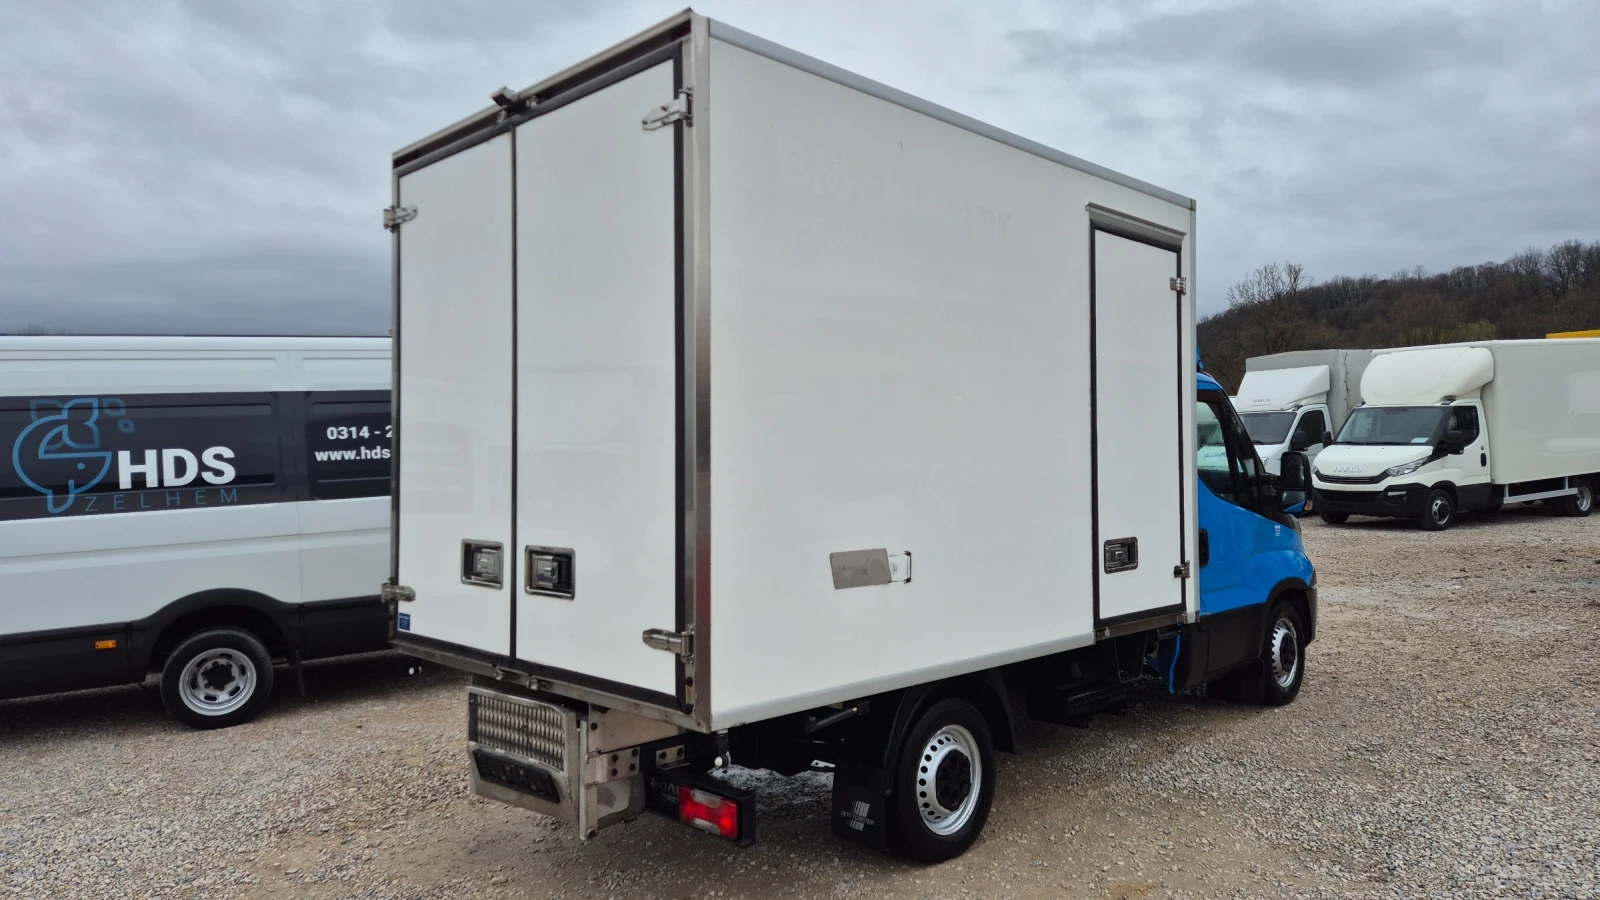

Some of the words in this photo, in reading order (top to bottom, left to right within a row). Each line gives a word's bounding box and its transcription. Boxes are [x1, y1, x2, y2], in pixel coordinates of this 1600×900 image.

[327, 426, 370, 440] 0314
[315, 446, 391, 461] www.hds
[118, 446, 236, 489] HDS
[1333, 465, 1363, 473] IVECO
[85, 488, 237, 512] ZELHEM
